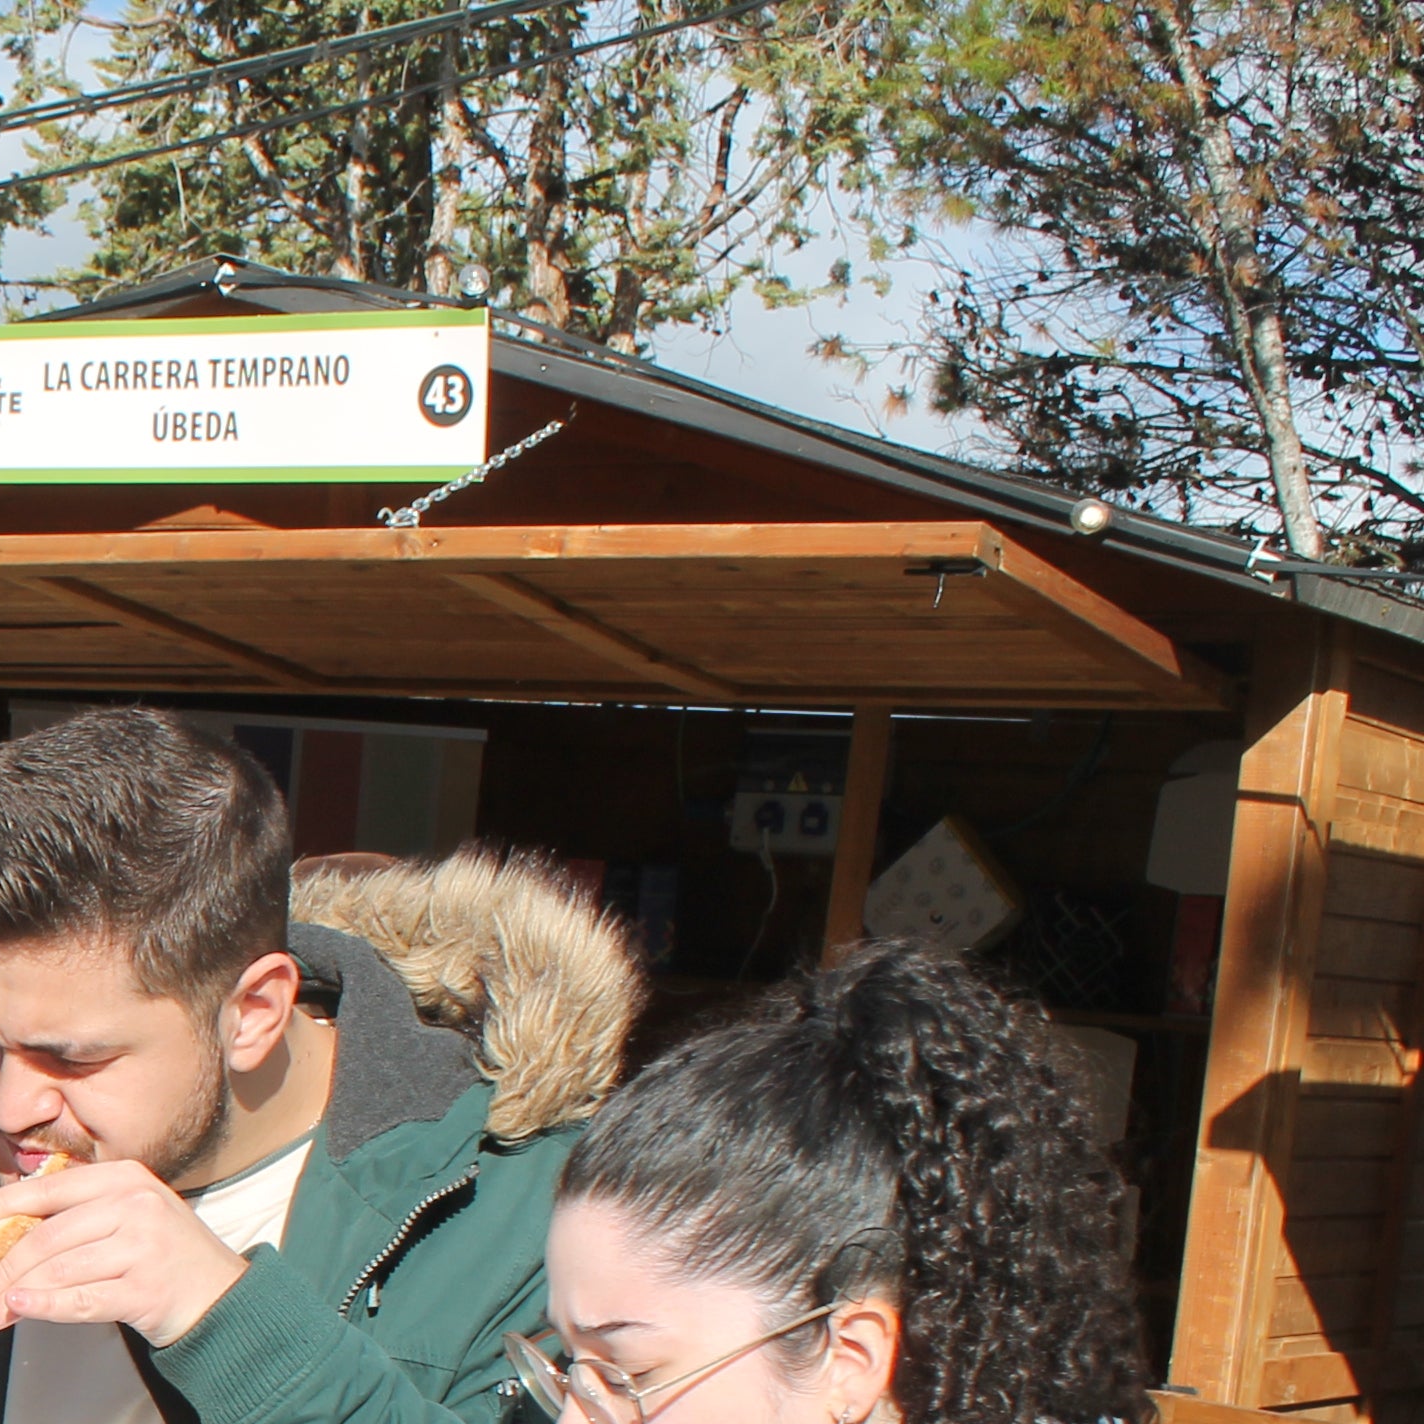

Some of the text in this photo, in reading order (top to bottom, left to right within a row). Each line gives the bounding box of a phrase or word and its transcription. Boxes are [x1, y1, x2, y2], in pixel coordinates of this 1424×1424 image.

[41, 354, 351, 392] LA CARRERA TEMPRANO
[423, 375, 465, 415] 43
[151, 406, 240, 442] ÚBEDA
